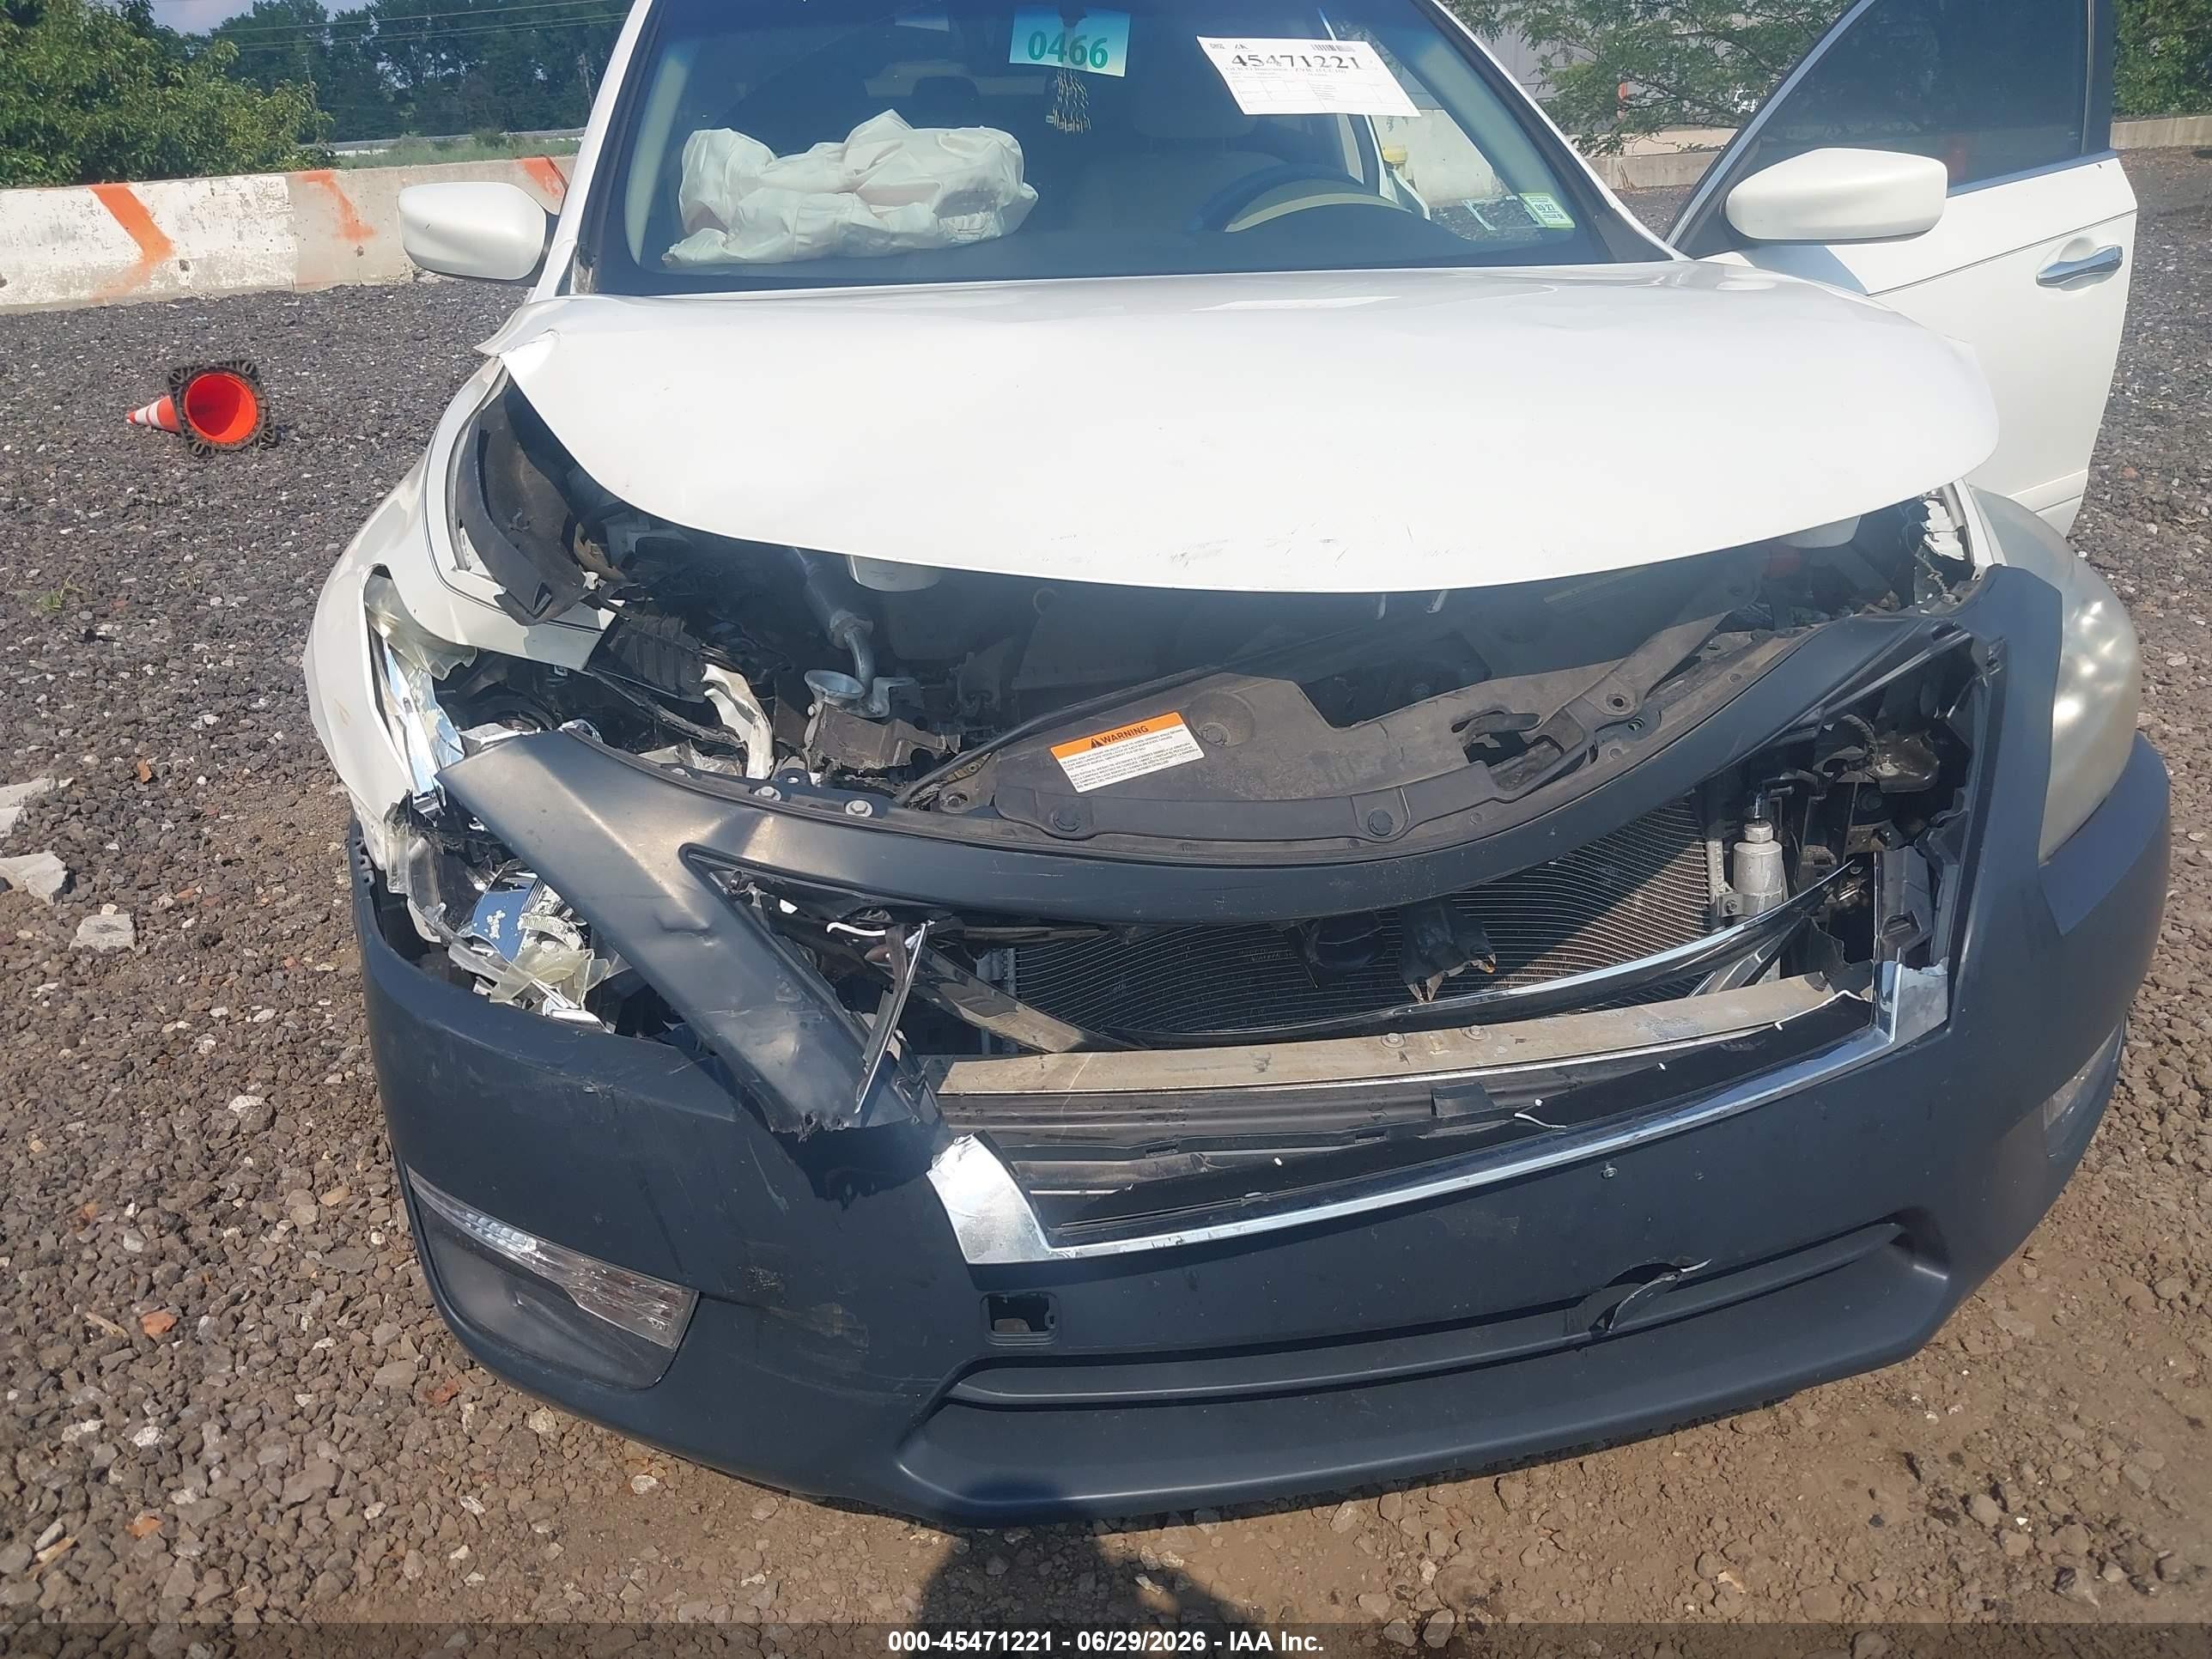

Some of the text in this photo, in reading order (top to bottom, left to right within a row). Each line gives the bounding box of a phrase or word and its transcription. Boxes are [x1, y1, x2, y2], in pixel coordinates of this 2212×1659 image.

[1028, 30, 1109, 70] 0466
[1231, 54, 1361, 70] 45471221
[1100, 725, 1149, 744] WARNING
